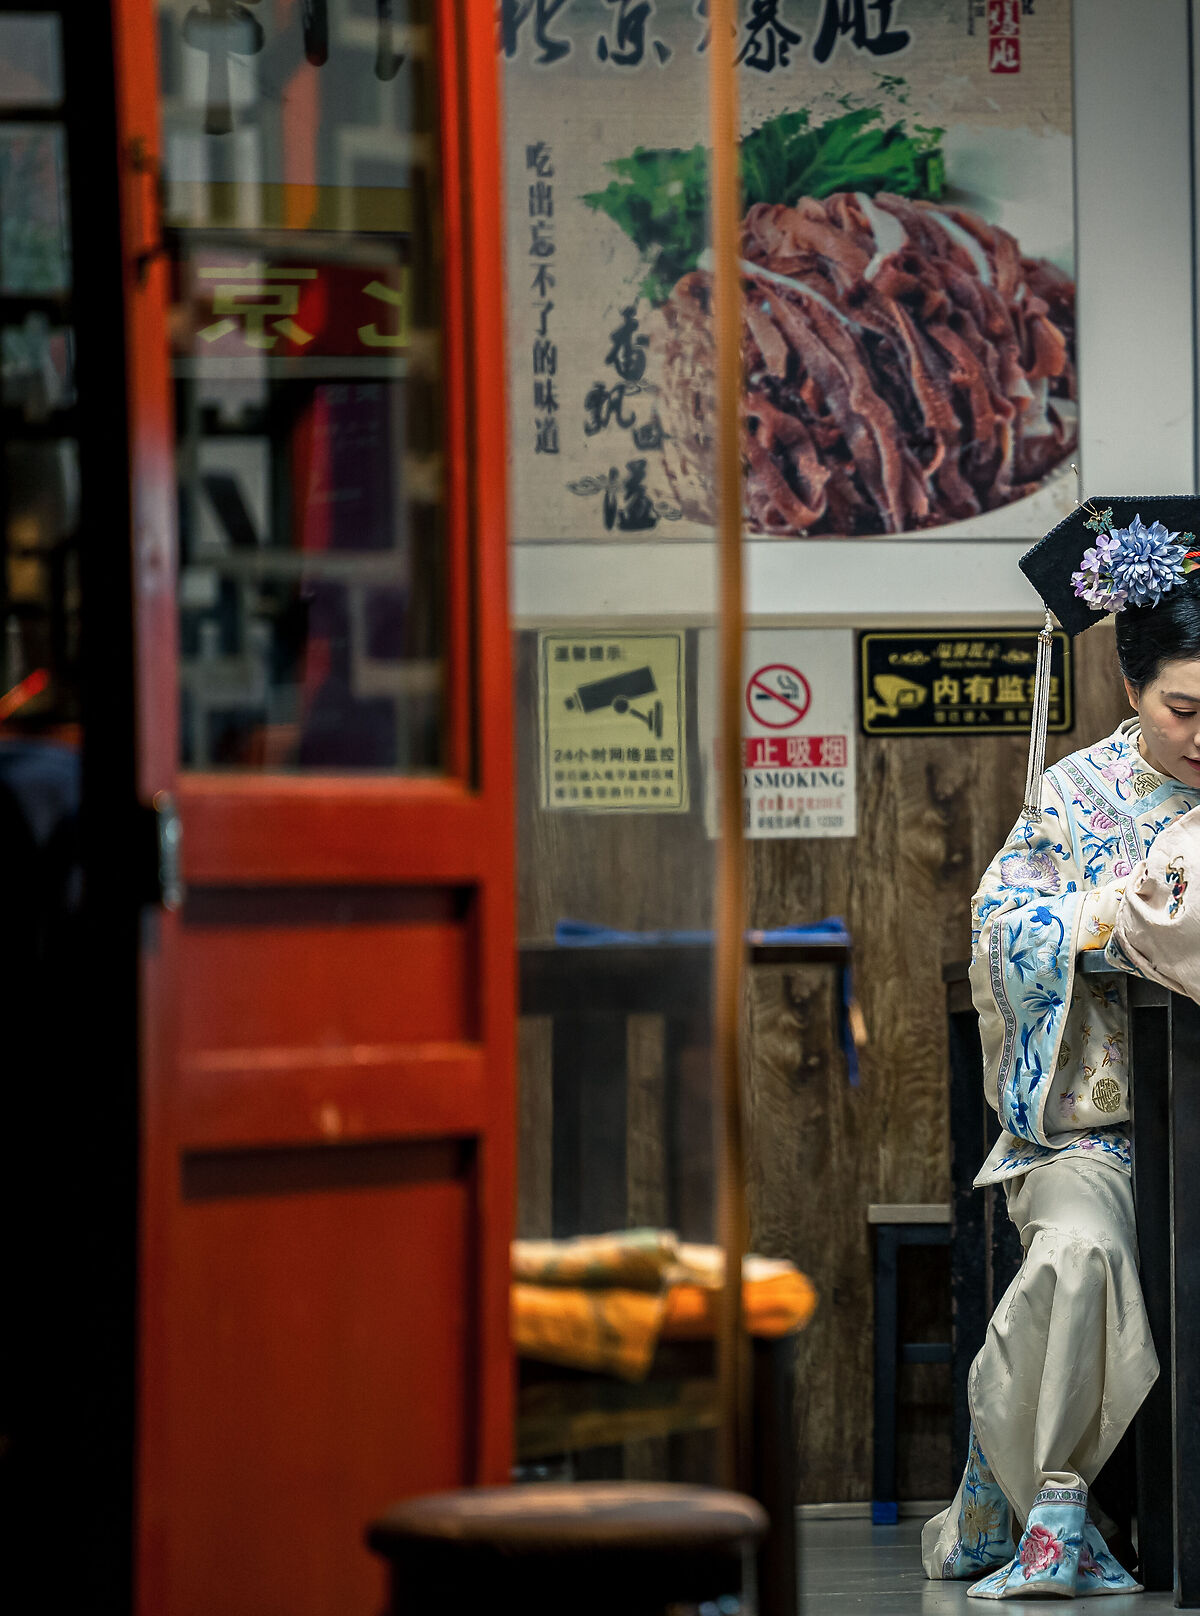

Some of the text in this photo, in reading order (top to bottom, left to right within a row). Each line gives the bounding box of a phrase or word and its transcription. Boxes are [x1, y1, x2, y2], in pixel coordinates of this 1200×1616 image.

[525, 142, 560, 455] 吃出忘不了的味道
[742, 737, 846, 766] 止吸烟
[754, 772, 845, 788] SMOKING
